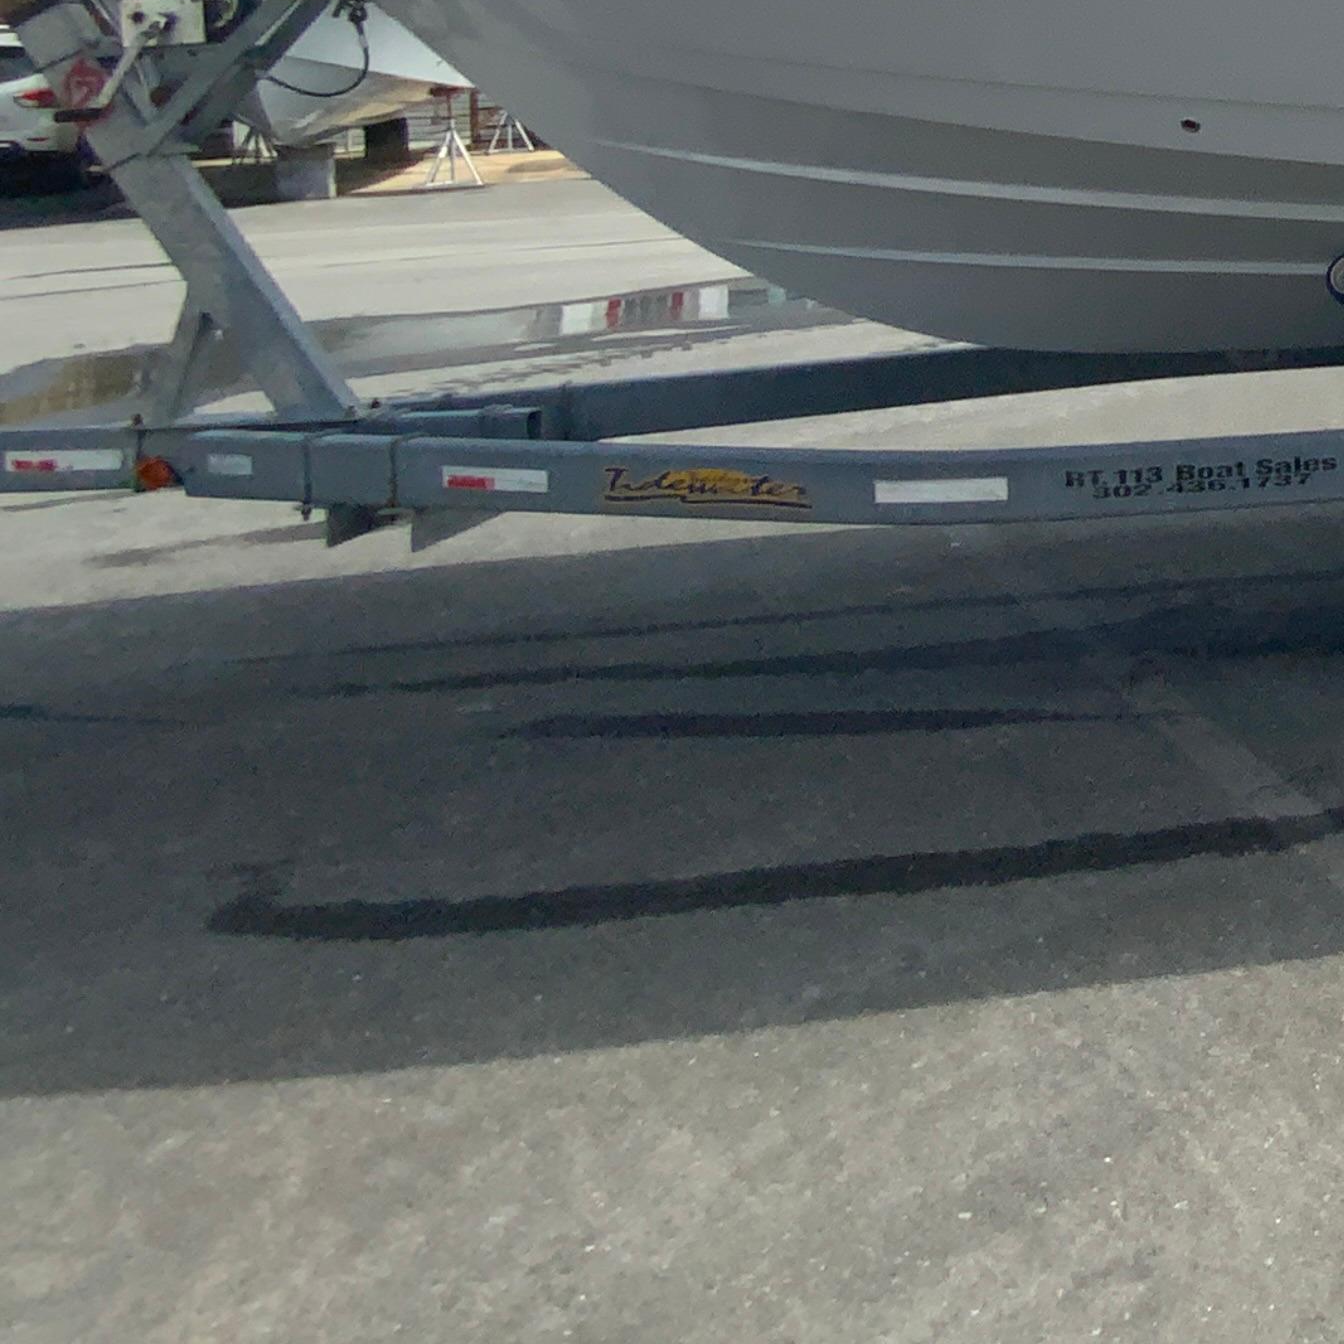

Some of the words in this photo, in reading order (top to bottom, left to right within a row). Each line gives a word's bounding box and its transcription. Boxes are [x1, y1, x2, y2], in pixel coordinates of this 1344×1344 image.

[1116, 466, 1163, 485] 113
[1175, 461, 1245, 481] Boat
[1255, 456, 1338, 476] Sales
